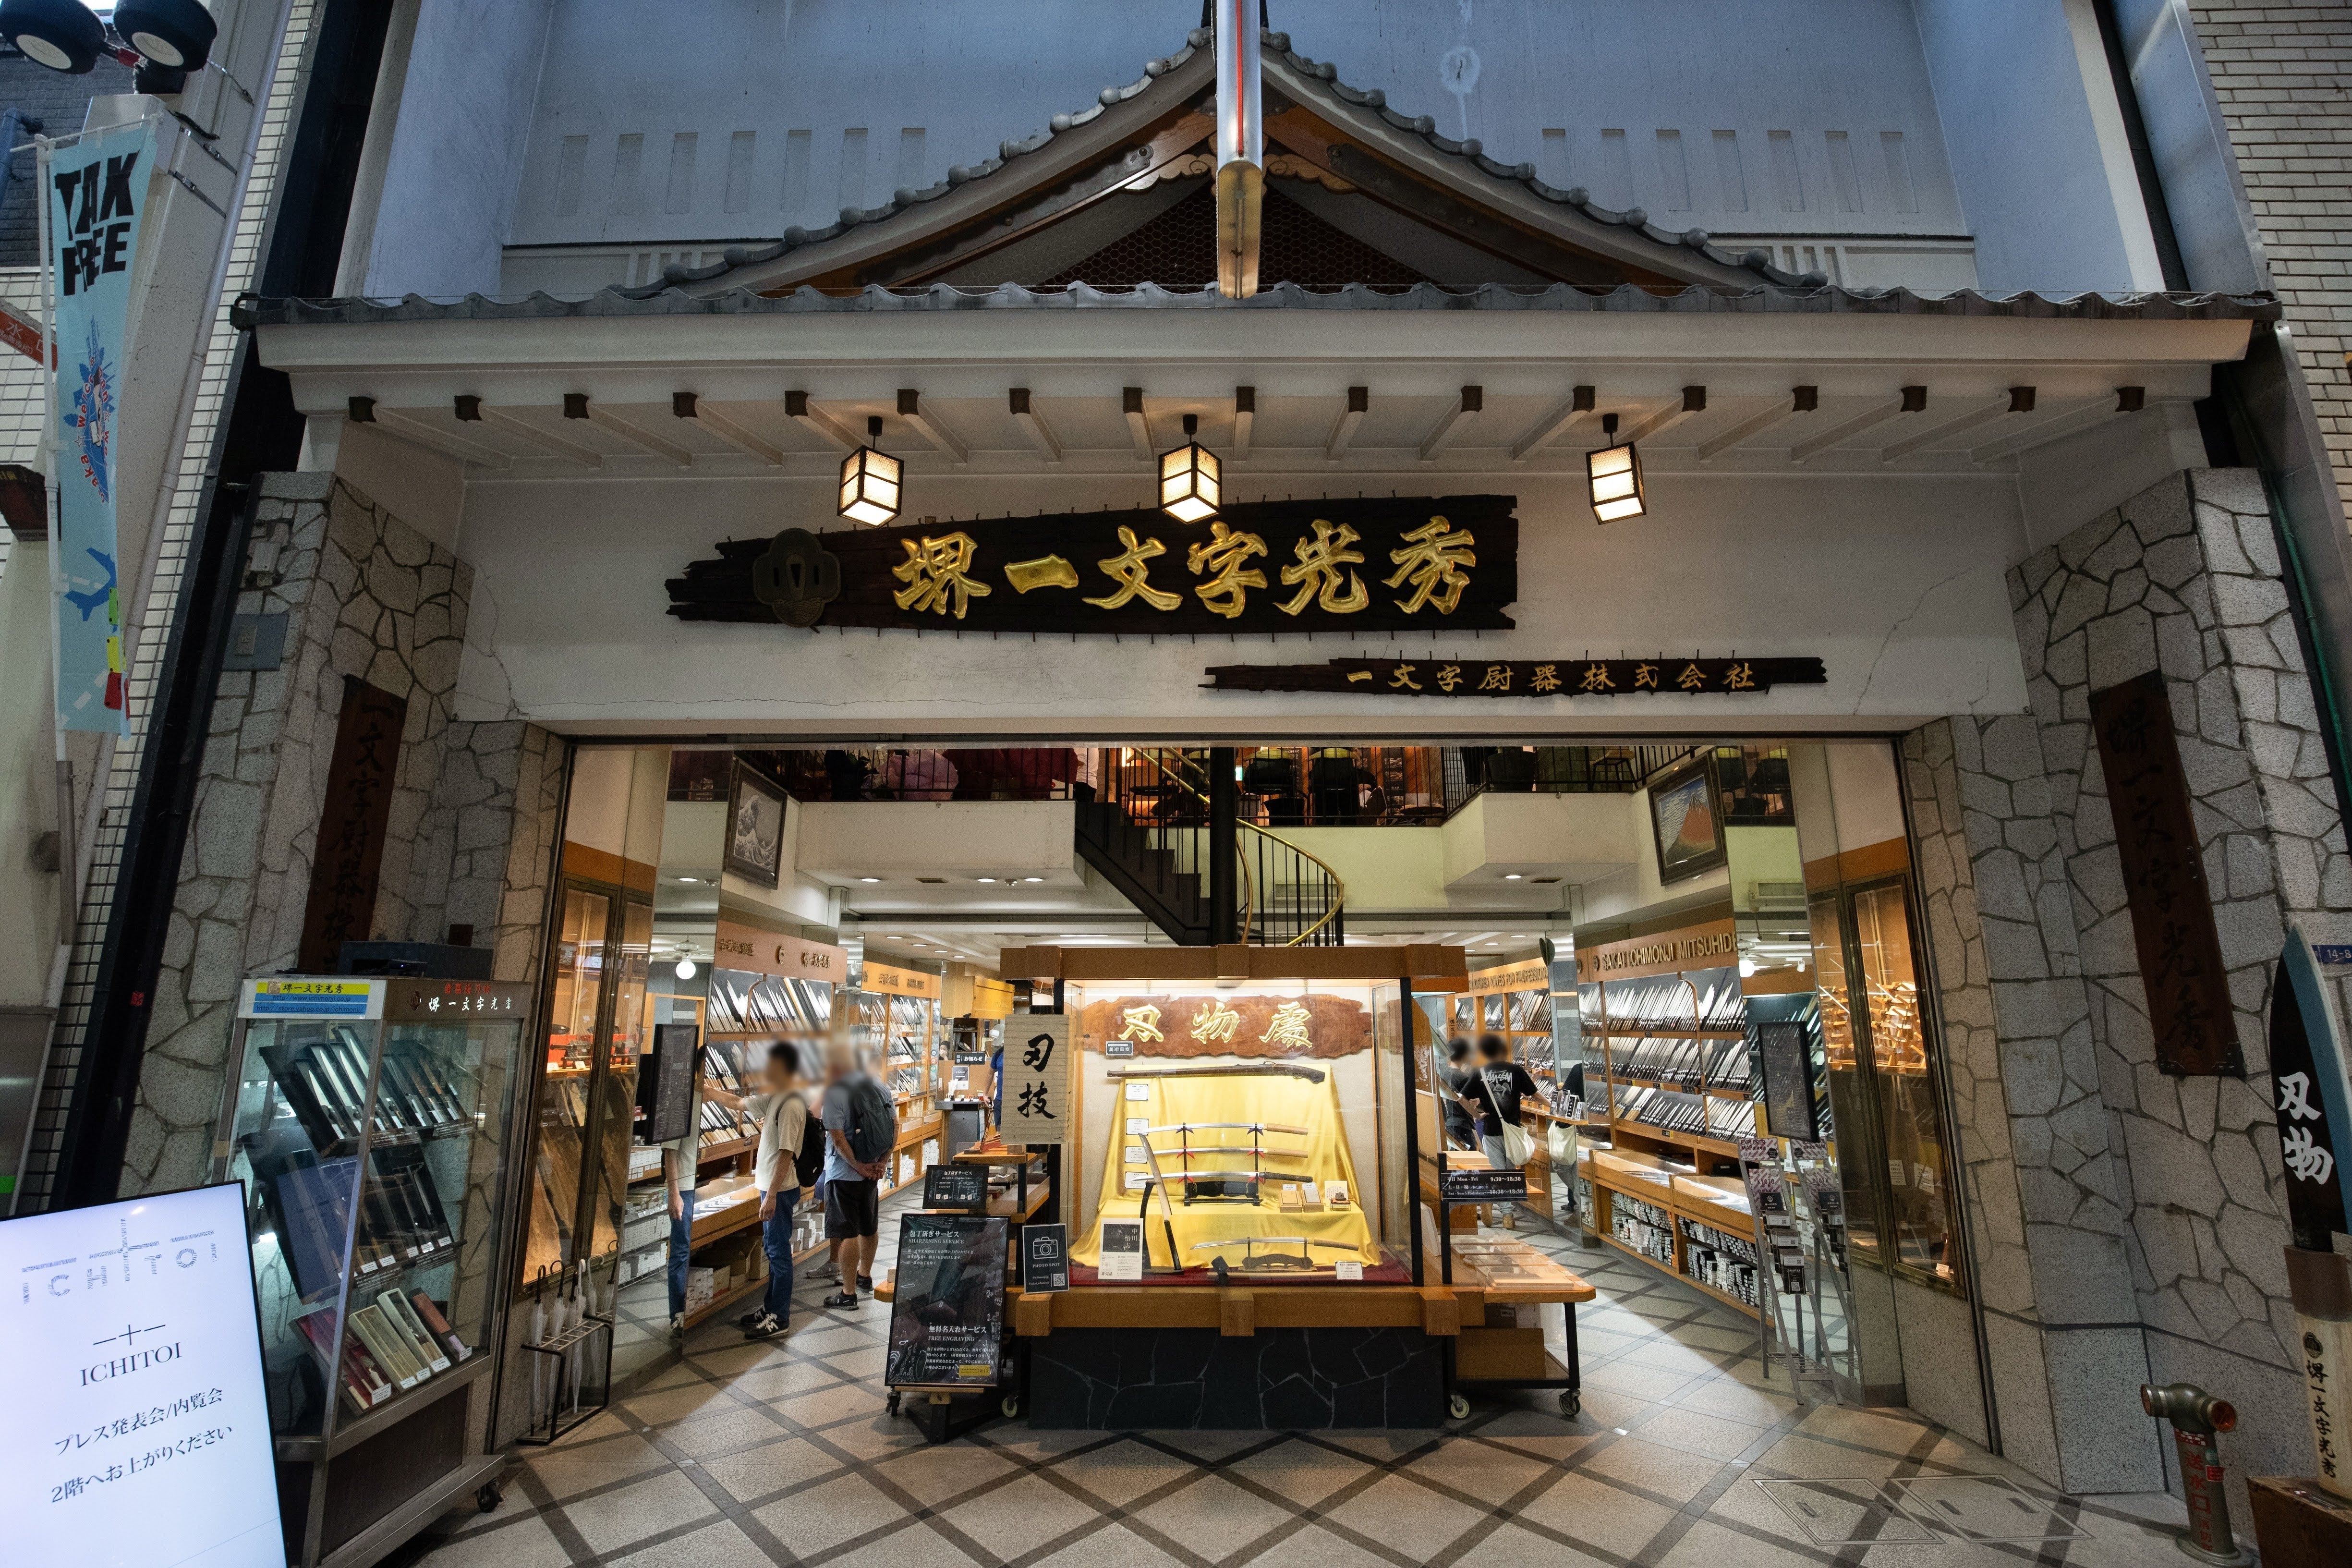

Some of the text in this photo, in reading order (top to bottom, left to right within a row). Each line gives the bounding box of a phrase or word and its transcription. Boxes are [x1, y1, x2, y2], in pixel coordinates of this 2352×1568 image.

[54, 149, 140, 241] TAX
[62, 222, 131, 296] FREE
[892, 515, 1477, 620] 堺一文字光秀
[1346, 662, 1757, 692] 一文字厨器株式会社
[283, 984, 344, 994] 堺一文字光秀
[1601, 952, 1625, 971] SAKAI
[1626, 942, 1673, 967] ICHIMONJI
[428, 996, 512, 1012] 堺一文字光秀
[2278, 1071, 2334, 1185] 刃物
[1132, 1228, 1138, 1241] 中川
[80, 1341, 182, 1387] ICHITOI
[55, 1387, 223, 1456] プレス発表会/内覧会
[2306, 1360, 2337, 1478] 堺一文字光秀
[50, 1424, 232, 1503] 2階へお上がりください
